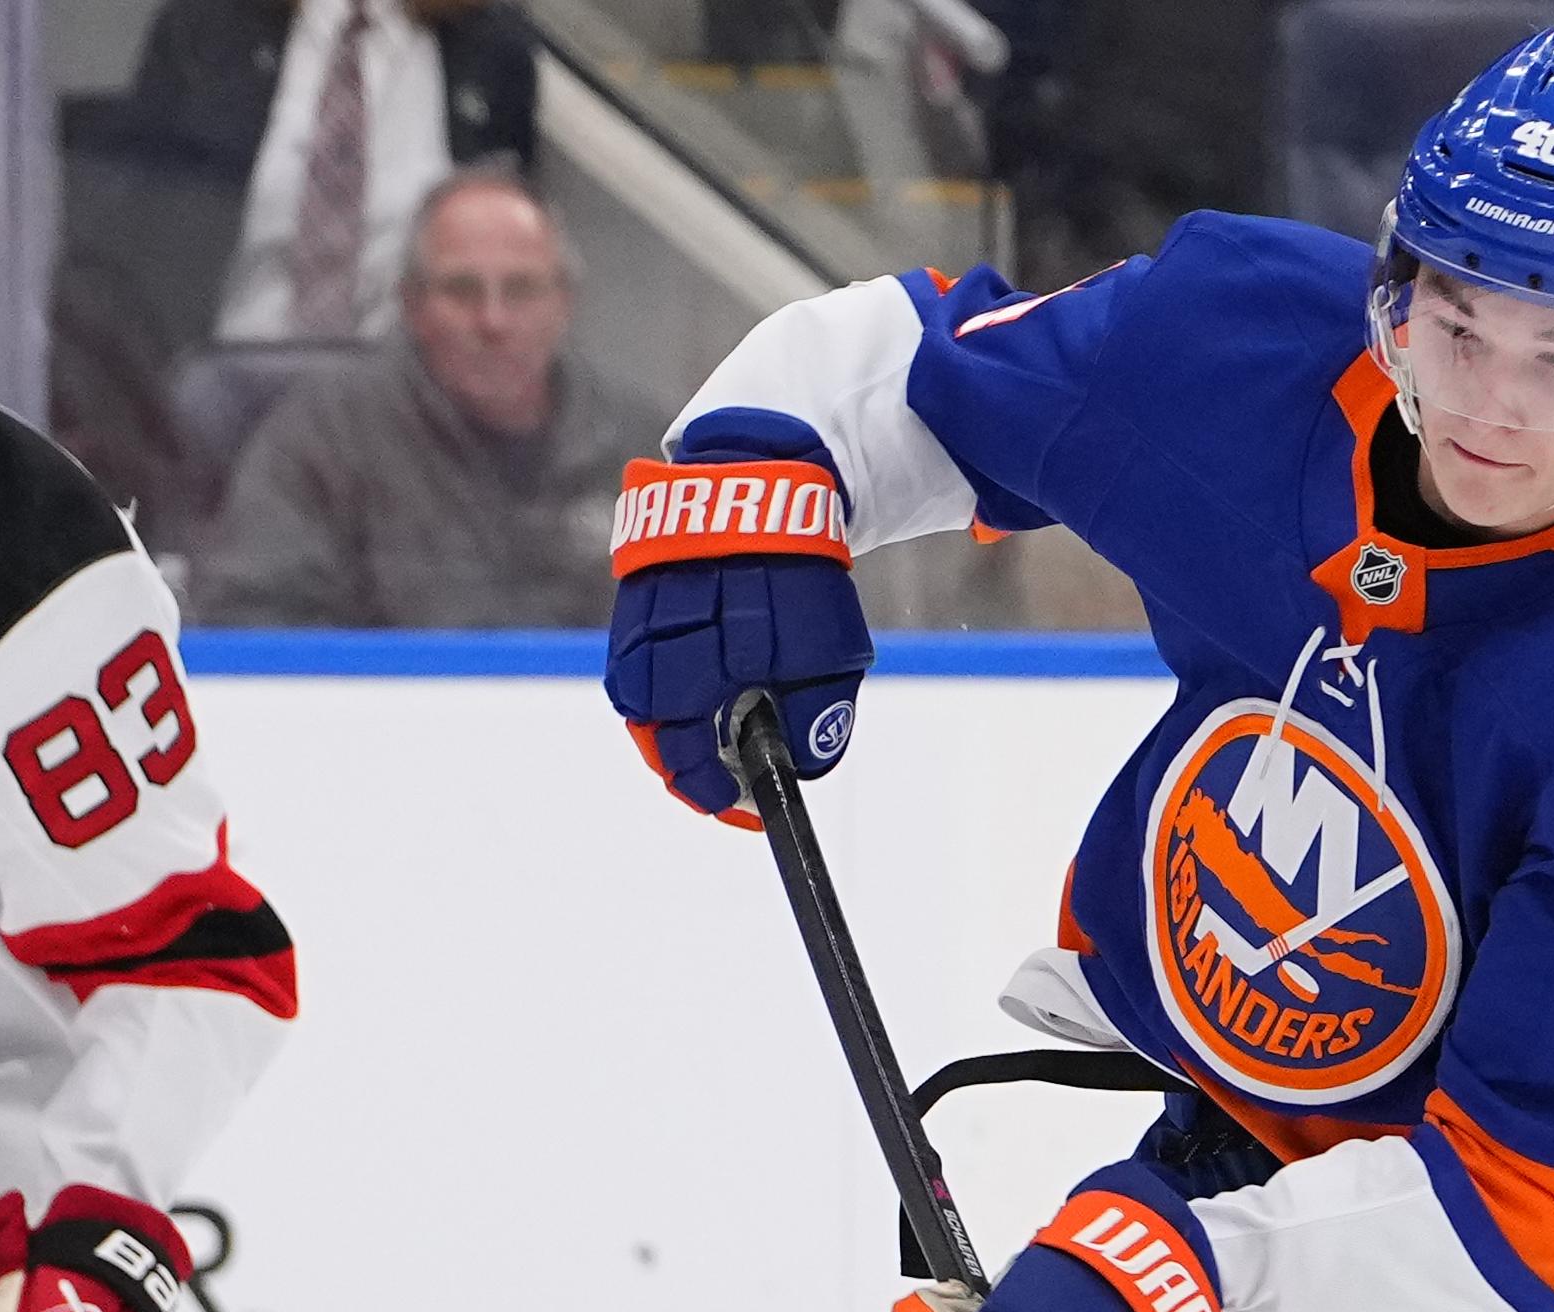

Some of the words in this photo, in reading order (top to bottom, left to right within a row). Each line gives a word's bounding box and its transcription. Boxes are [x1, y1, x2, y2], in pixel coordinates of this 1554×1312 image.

[1360, 565, 1397, 586] NHL
[2, 628, 198, 849] 83
[1167, 838, 1377, 1061] ISLANDERS
